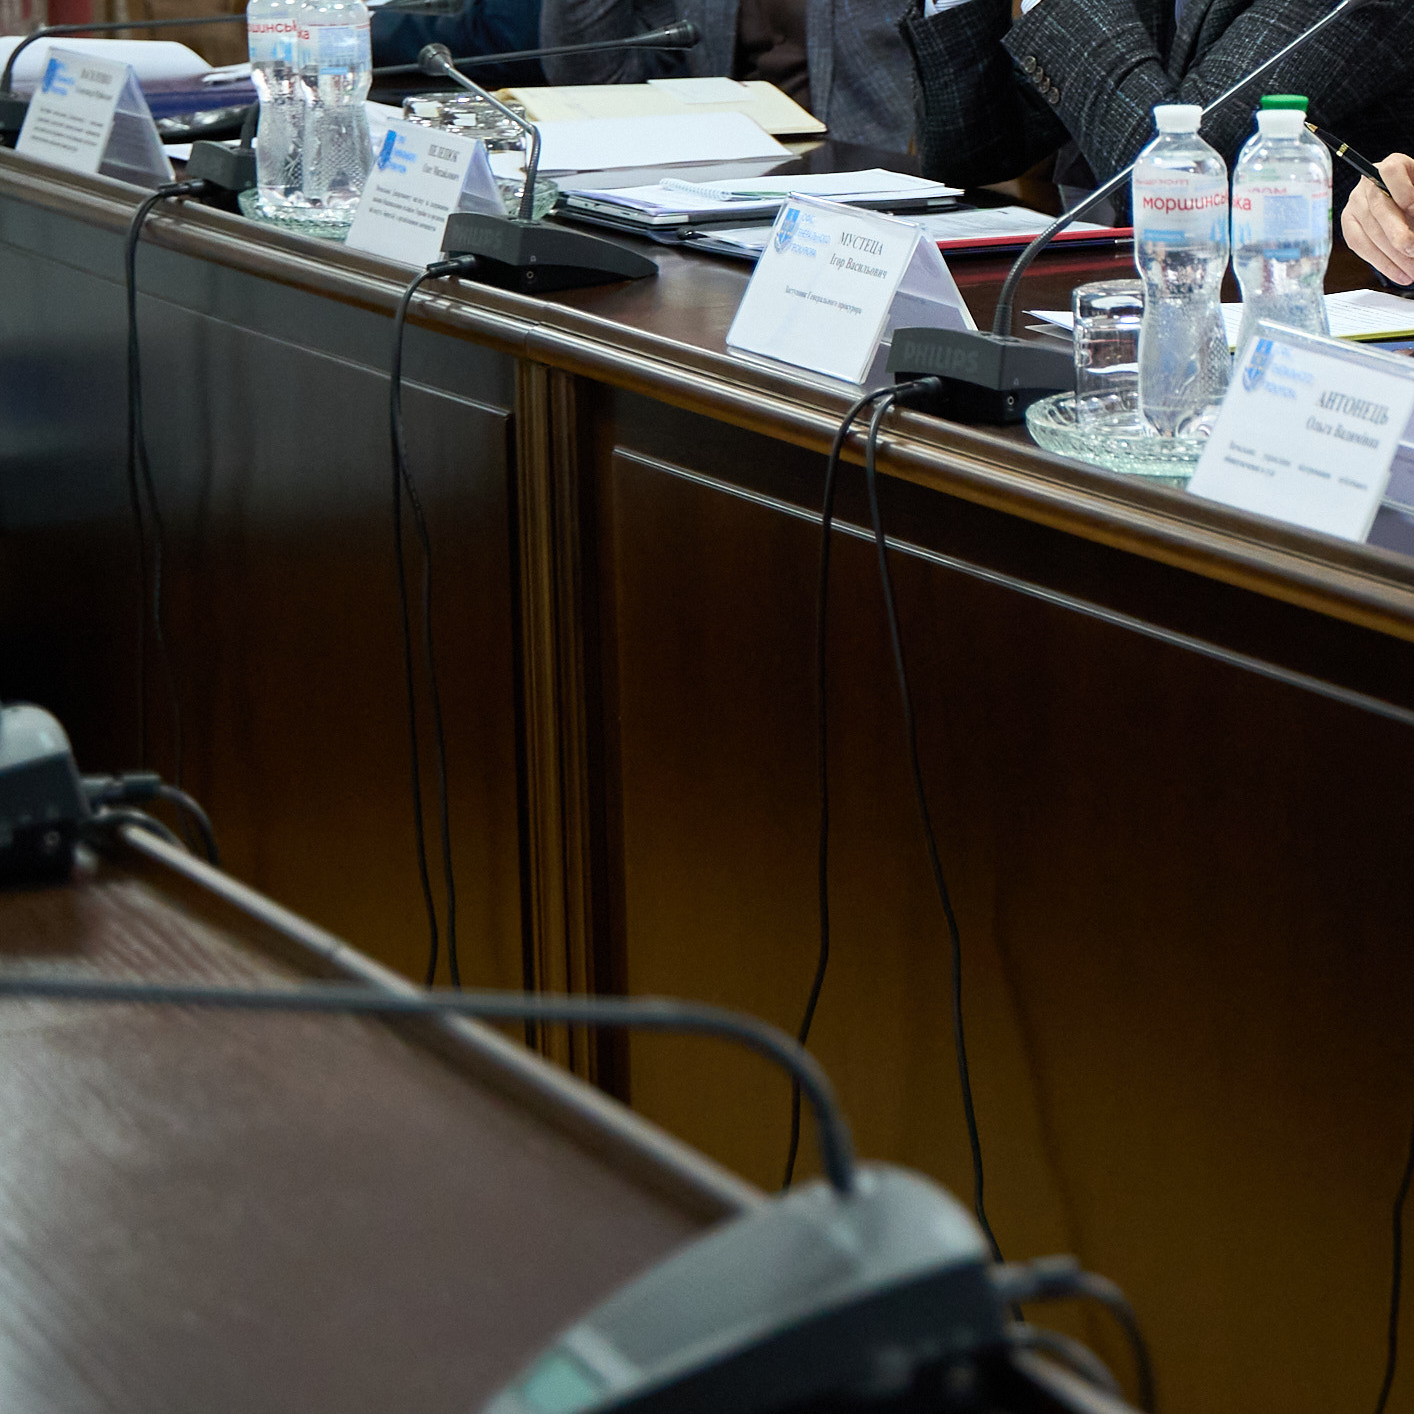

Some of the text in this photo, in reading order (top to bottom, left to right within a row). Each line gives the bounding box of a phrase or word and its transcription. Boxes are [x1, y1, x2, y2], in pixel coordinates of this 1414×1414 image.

[840, 232, 883, 255] МУСТЕЦА
[830, 253, 888, 279] Ігор Васильович
[903, 341, 979, 373] PHILIPS
[1316, 391, 1389, 425] АНТОНЕЦЬ
